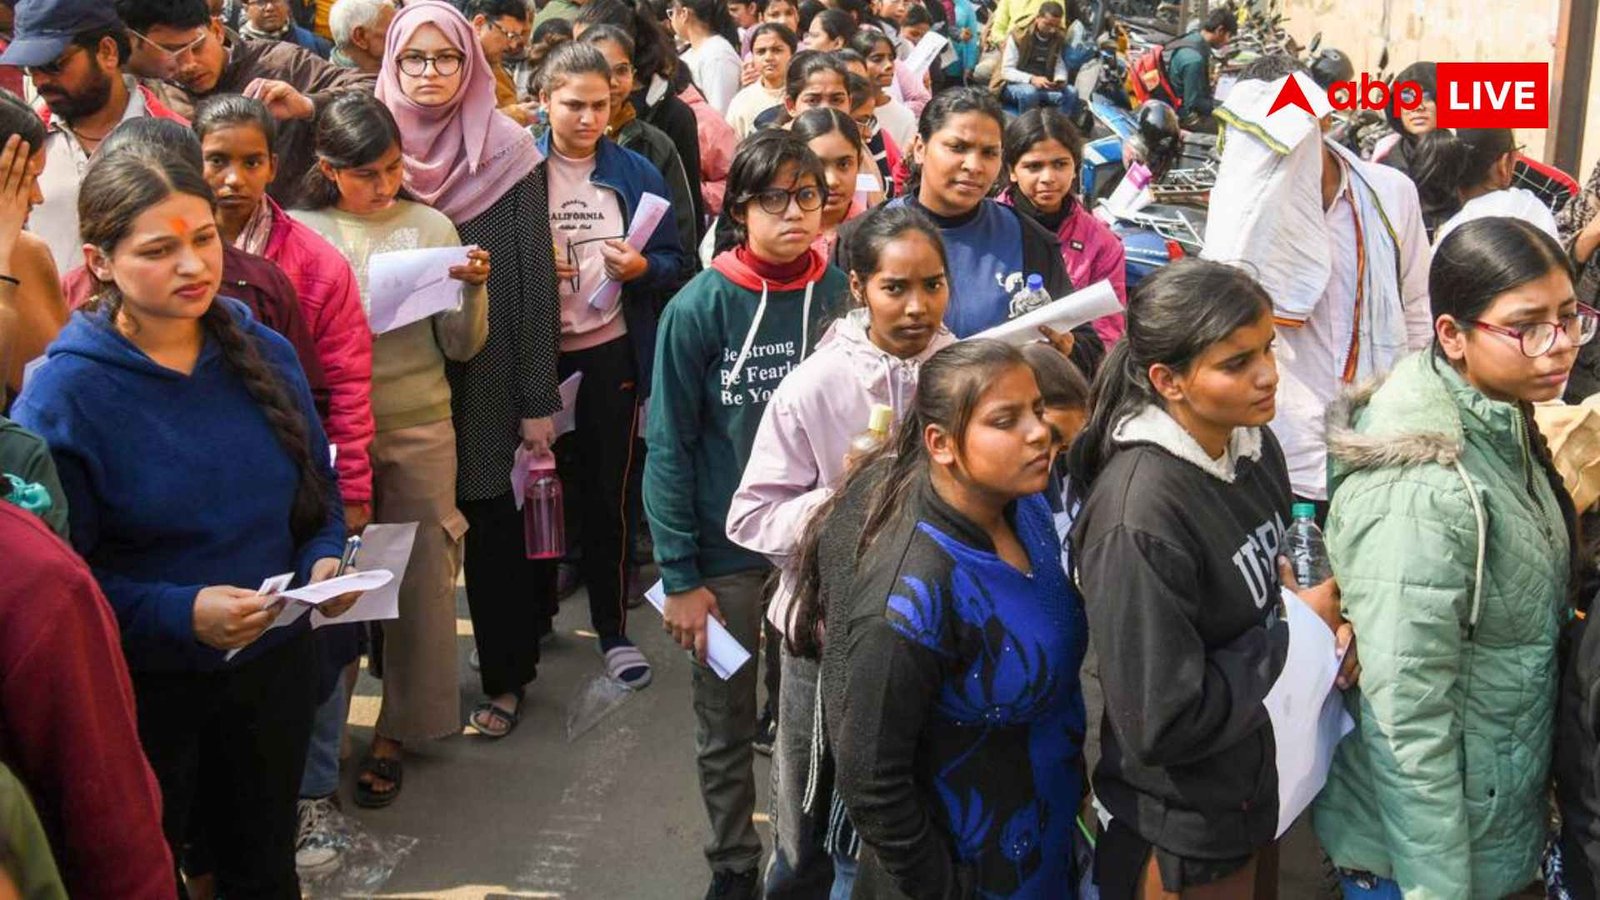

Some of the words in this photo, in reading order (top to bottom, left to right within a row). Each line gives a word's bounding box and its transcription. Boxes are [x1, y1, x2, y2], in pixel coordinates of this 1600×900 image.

[550, 212, 604, 221] ALIFORNIA
[720, 369, 741, 385] Be
[720, 390, 743, 405] Be
[748, 387, 777, 403] Yo
